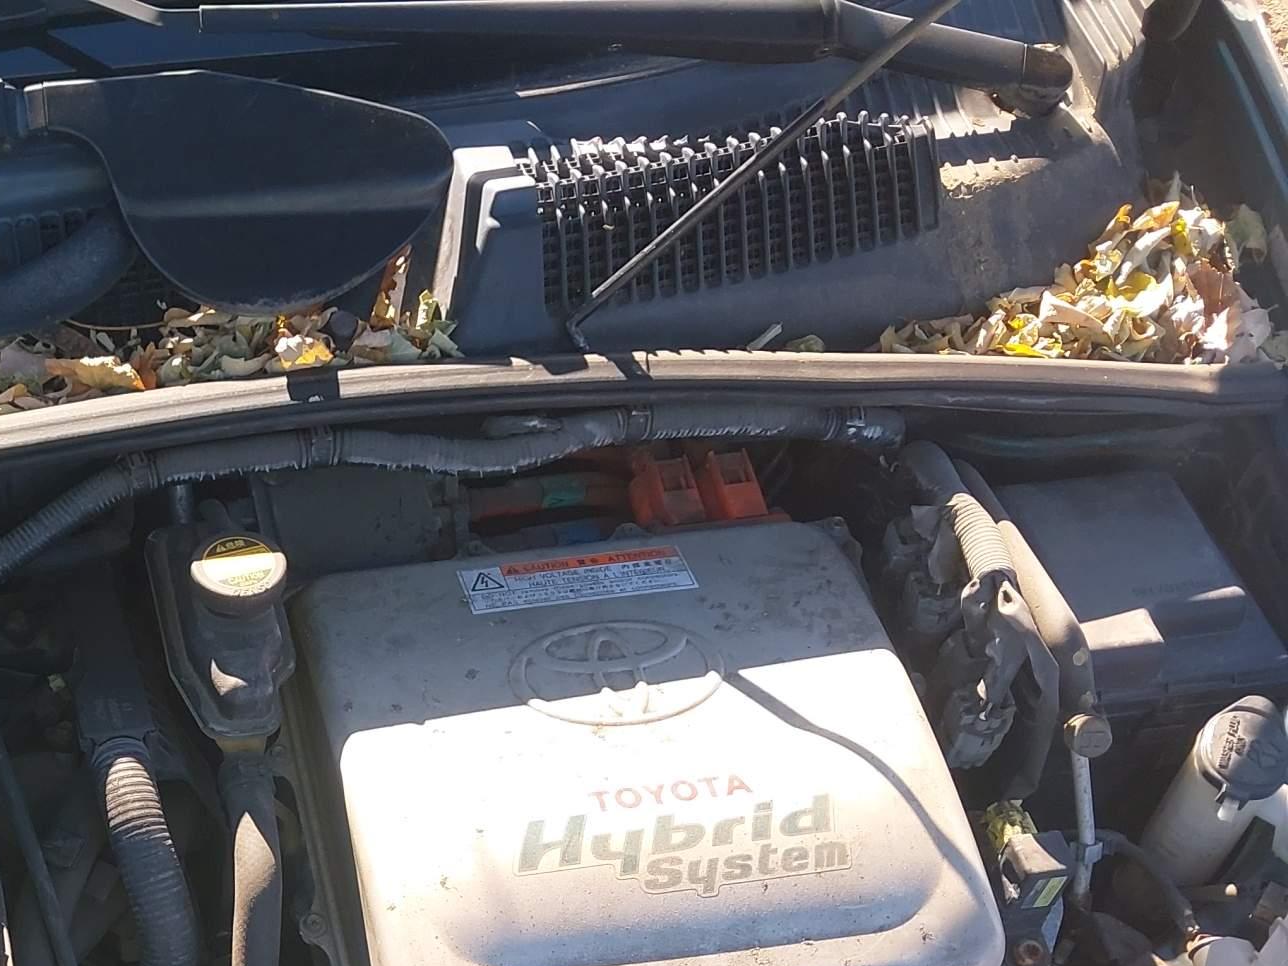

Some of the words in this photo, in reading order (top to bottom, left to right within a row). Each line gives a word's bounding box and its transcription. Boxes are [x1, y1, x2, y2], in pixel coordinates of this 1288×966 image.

[523, 558, 569, 573] CAUTION
[607, 548, 666, 564] ATTENTION
[541, 569, 579, 581] VOLTAGE
[589, 775, 752, 812] TOYOTA
[517, 793, 832, 876] Hybrid
[644, 840, 850, 897] System
